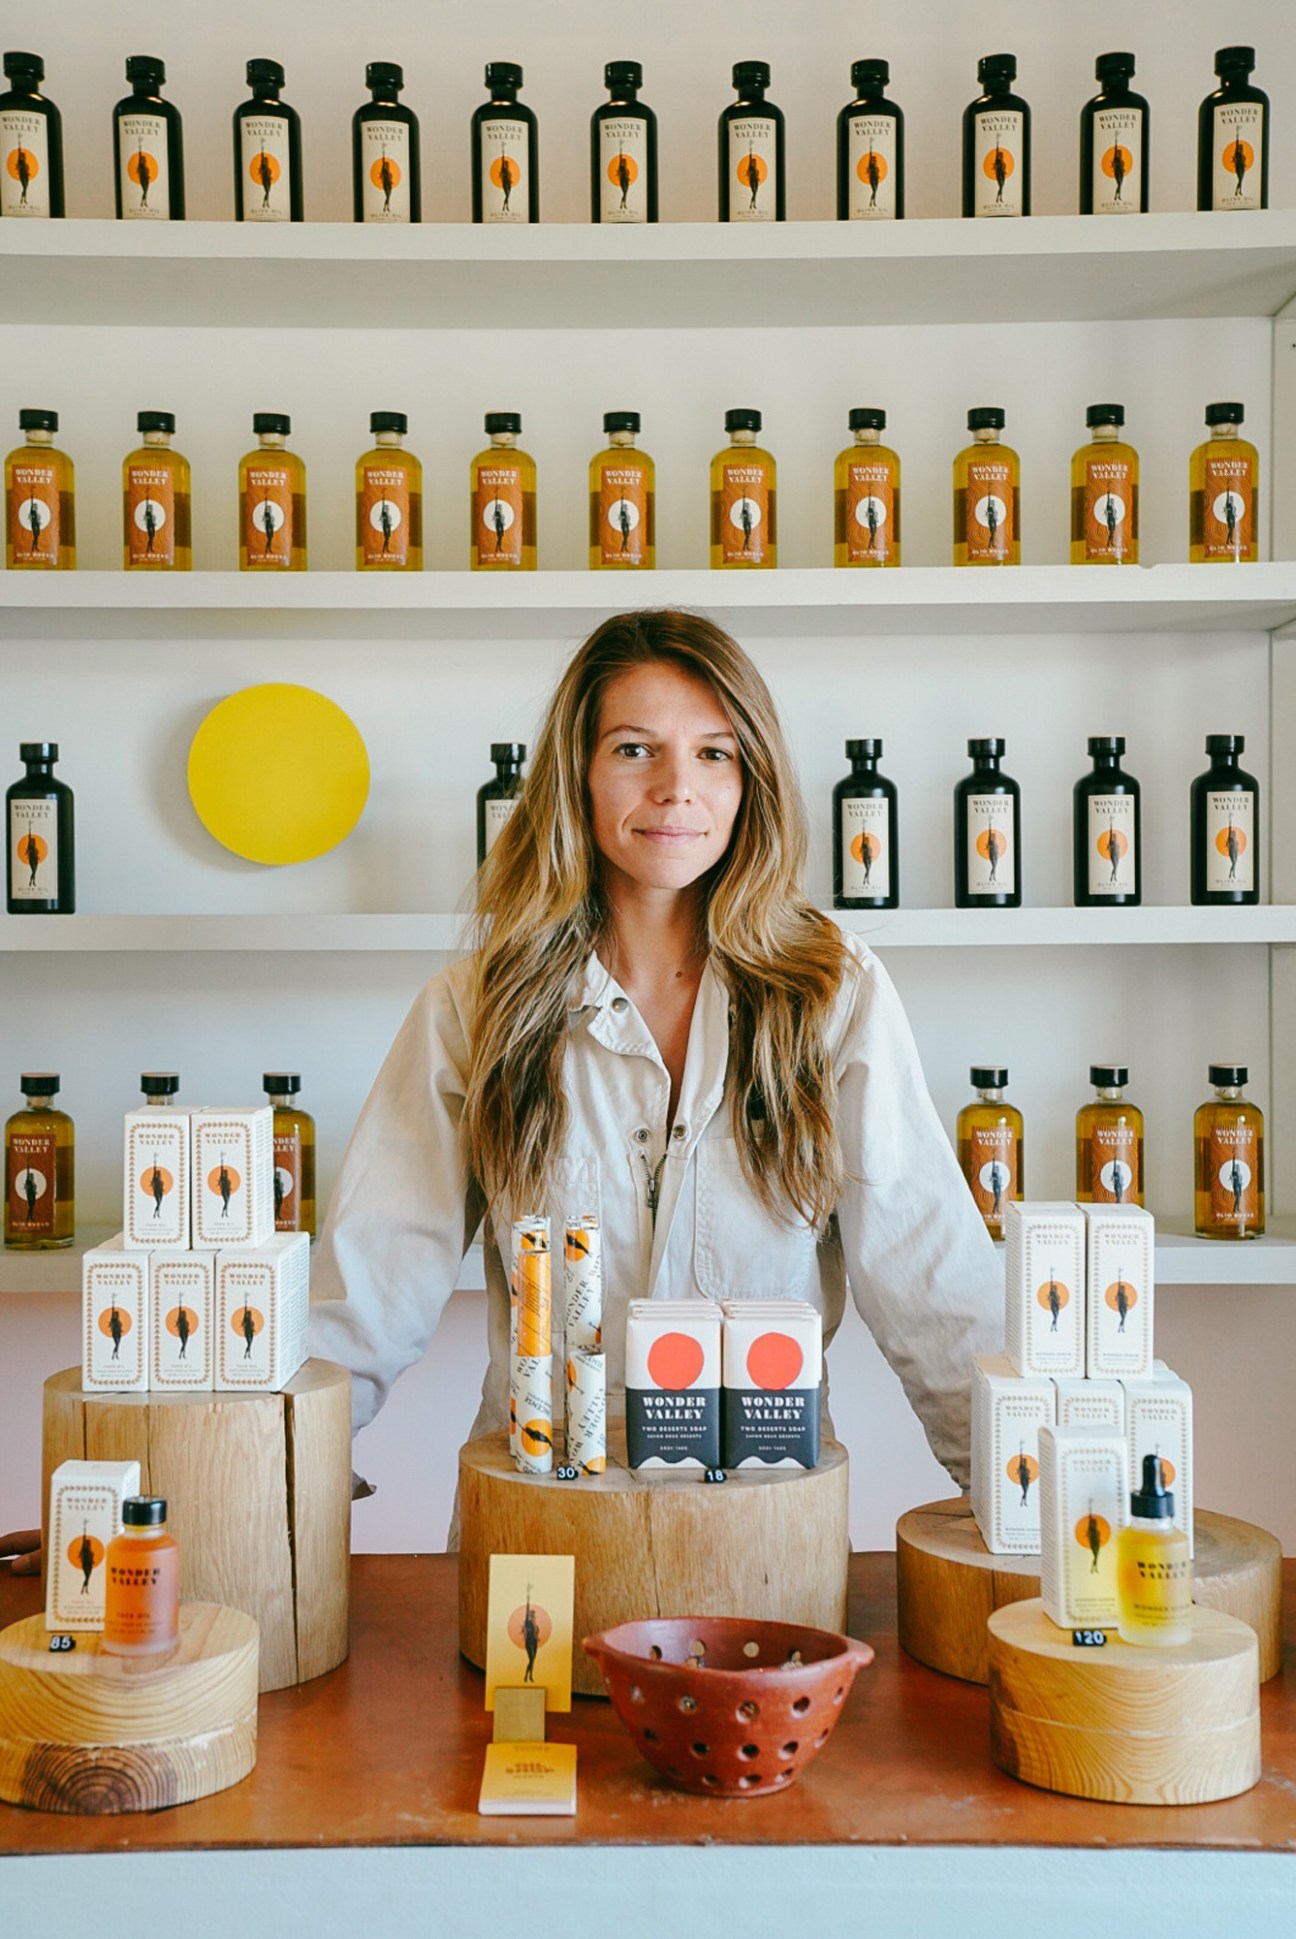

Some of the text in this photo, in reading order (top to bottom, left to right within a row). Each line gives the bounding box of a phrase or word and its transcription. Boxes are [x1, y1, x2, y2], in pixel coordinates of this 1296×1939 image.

[1220, 108, 1257, 117] WONDER
[2, 116, 41, 125] WONDER
[980, 116, 1017, 124] WONDER
[1098, 114, 1137, 122] WONDER
[1221, 116, 1256, 124] VALLEY
[123, 119, 161, 128] WONDER
[245, 121, 283, 130] WONDER
[604, 123, 641, 131] WONDER
[734, 123, 770, 131] WONDER
[853, 120, 891, 128] WONDER
[1100, 121, 1135, 130] VALLEY
[4, 123, 40, 133] VALLEY
[124, 128, 160, 136] VALLEY
[366, 126, 404, 134] WONDER
[486, 125, 522, 133] WONDER
[855, 128, 889, 136] VALLEY
[982, 124, 1016, 132] VALLEY
[246, 129, 281, 137] VALLEY
[368, 133, 402, 141] VALLEY
[487, 132, 521, 141] VALLEY
[735, 130, 769, 138] VALLEY
[1091, 463, 1128, 471] WONDER
[1210, 461, 1248, 469] WONDER
[15, 469, 53, 477] WONDER
[132, 470, 168, 478] WONDER
[605, 470, 642, 478] WONDER
[727, 469, 764, 477] WONDER
[852, 466, 889, 474] WONDER
[1211, 469, 1246, 477] VALLEY
[250, 471, 287, 479] WONDER
[367, 471, 404, 479] WONDER
[481, 471, 517, 479] WONDER
[854, 474, 887, 482] VALLEY
[974, 473, 1007, 481] VALLEY
[1093, 471, 1126, 479] VALLEY
[369, 478, 402, 486] VALLEY
[607, 477, 640, 485] VALLEY
[16, 810, 49, 819] VALLEY
[1097, 1130, 1134, 1138] WONDER
[1215, 1129, 1253, 1137] WONDER
[13, 1138, 50, 1146] WONDER
[978, 1138, 1012, 1146] VALLEY
[1099, 1137, 1132, 1145] VALLEY
[1217, 1136, 1251, 1145] VALLEY
[642, 1396, 706, 1407] WONDER
[741, 1396, 805, 1407] WONDER
[645, 1409, 704, 1419] VALLEY
[744, 1409, 802, 1419] VALLEY
[558, 1466, 575, 1479] 30
[708, 1470, 724, 1481] 18
[1137, 1561, 1186, 1570] WONDER
[111, 1567, 160, 1576] WONDER
[1139, 1570, 1185, 1580] VALLEY
[112, 1576, 157, 1586] VALLEY
[1075, 1631, 1104, 1644] 120
[51, 1636, 70, 1649] 85
